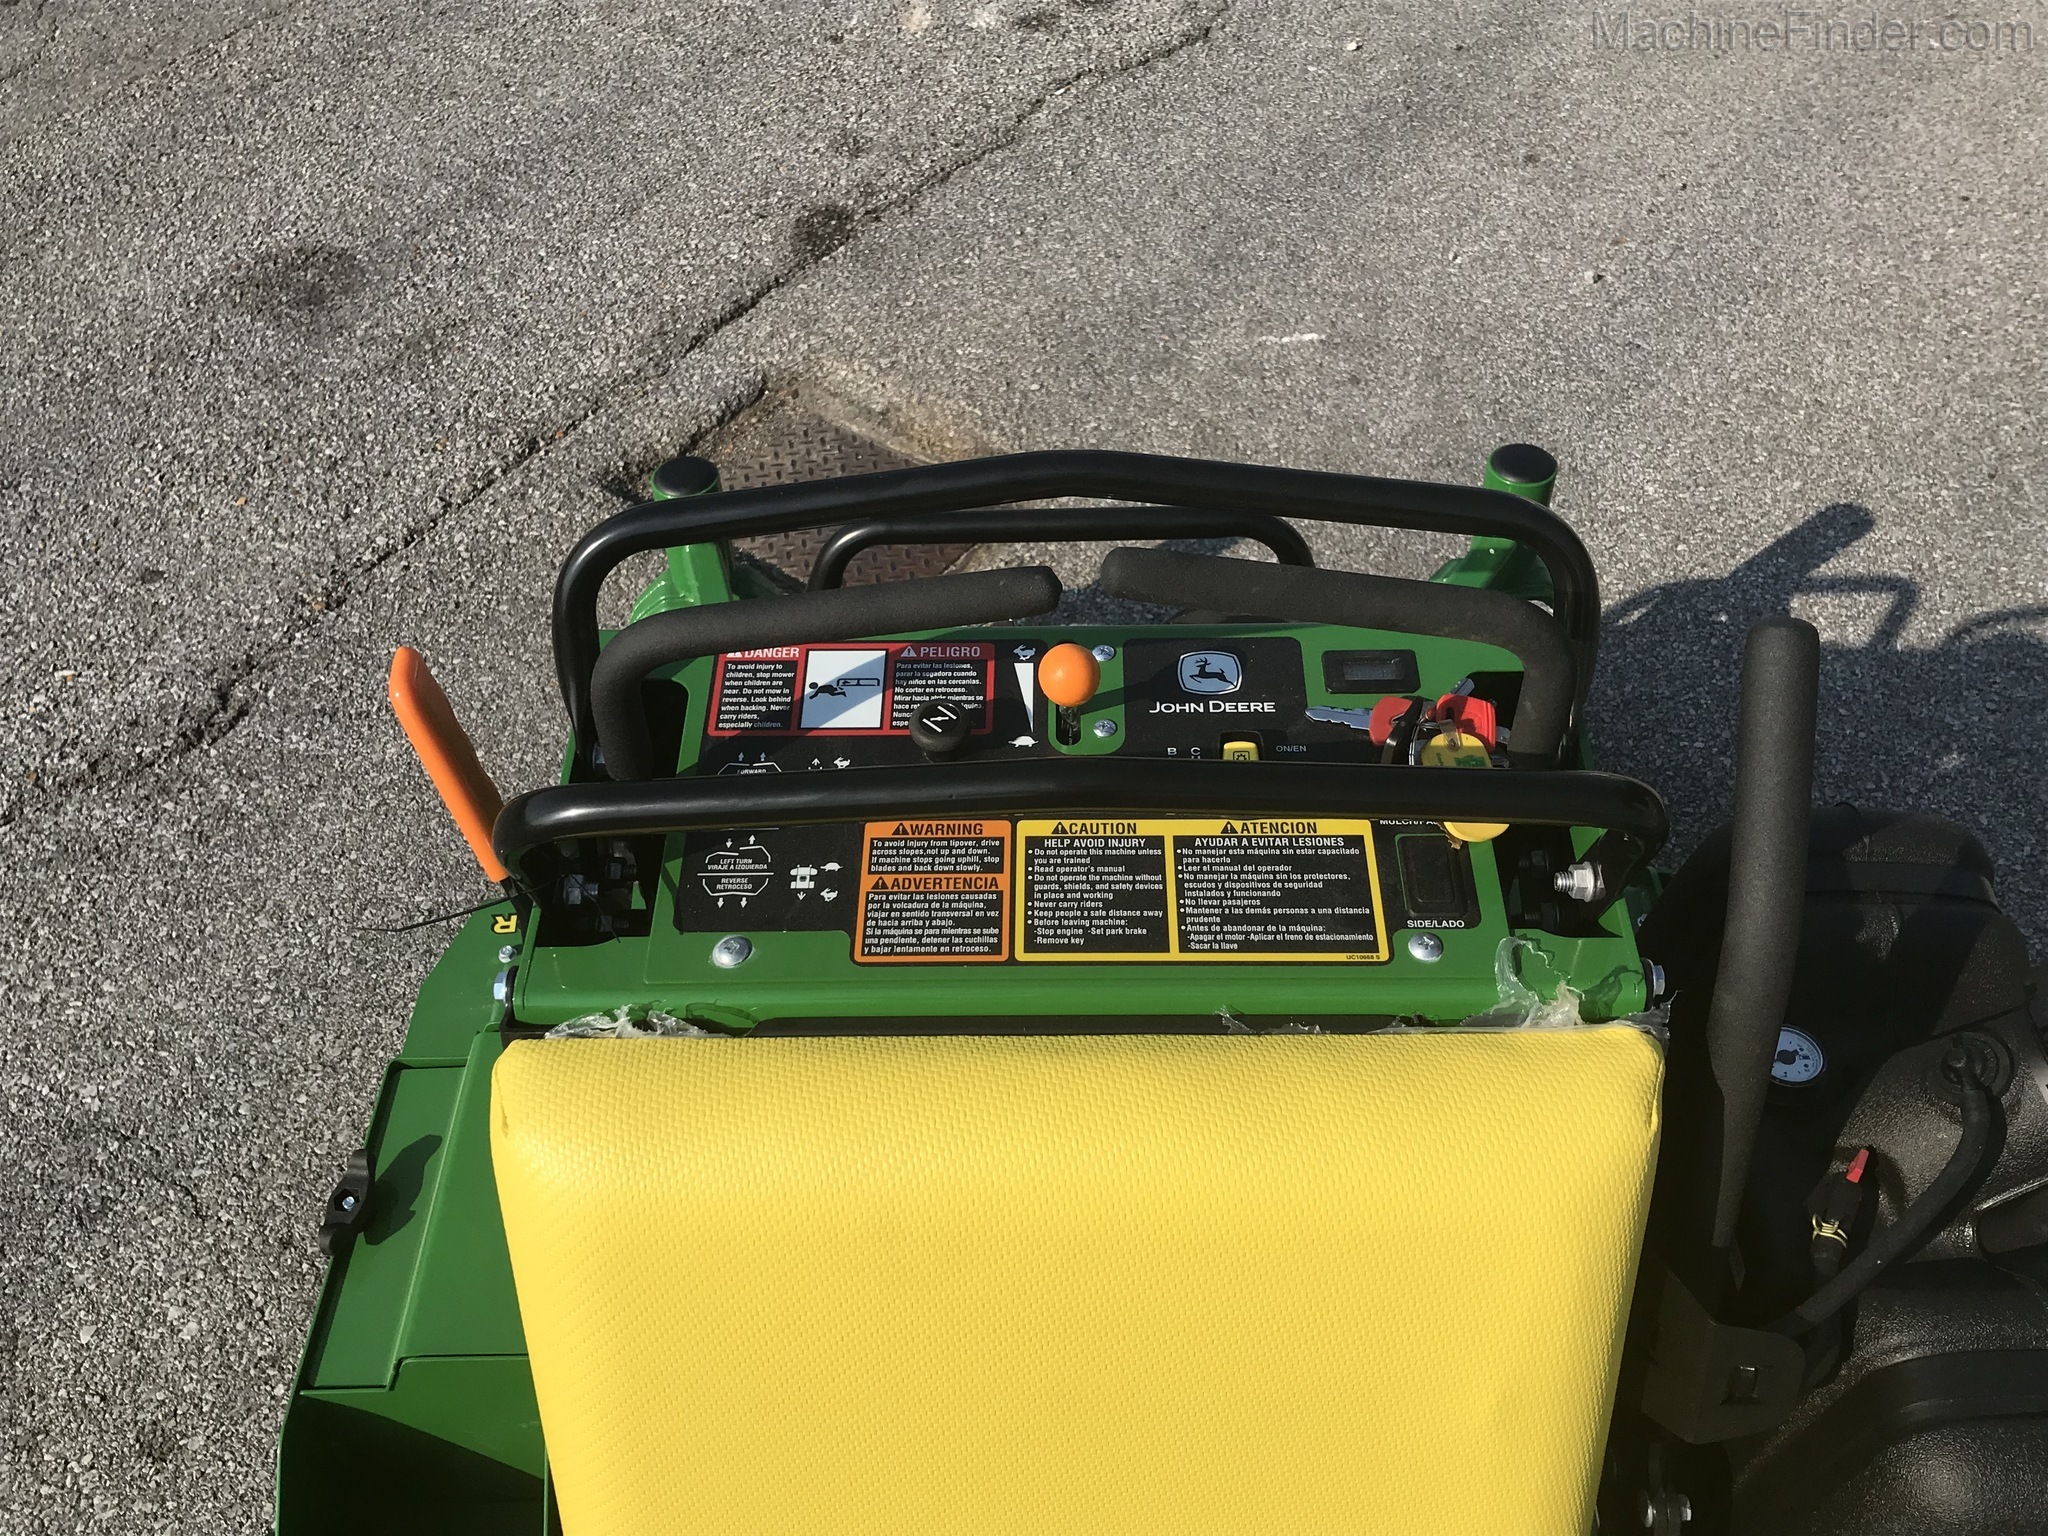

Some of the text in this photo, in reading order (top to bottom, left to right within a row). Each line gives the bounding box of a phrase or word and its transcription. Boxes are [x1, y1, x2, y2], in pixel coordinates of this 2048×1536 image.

[745, 647, 799, 658] DANGER
[920, 647, 980, 657] PELIGRO
[1149, 701, 1275, 713] JOHN DEERE
[910, 823, 983, 835] WARNING
[1069, 823, 1137, 834] CAUTION
[1241, 822, 1317, 834] ATENCION
[907, 840, 928, 848] injury
[1044, 839, 1145, 847] HELP AVOID INJURY
[1195, 838, 1344, 846] AYUDAR A EVITAR LESIONES
[913, 856, 933, 864] stops
[935, 856, 955, 864] going
[958, 856, 982, 864] uphill,
[956, 864, 983, 872] slowly.
[1257, 864, 1292, 872] operador
[891, 877, 999, 889] ADVERTENCIA
[1044, 892, 1064, 900] place
[1083, 892, 1113, 900] working
[952, 902, 986, 910] máquina,
[1058, 901, 1078, 909] carry
[1198, 898, 1220, 906] llevar
[1223, 898, 1260, 906] pasajeros
[1056, 909, 1081, 917] people
[932, 919, 955, 927] abajo.
[1106, 927, 1123, 935] park
[1213, 941, 1219, 949] la
[1221, 941, 1238, 949] llave
[871, 945, 891, 954] bajar
[893, 945, 937, 953] lentamente
[952, 945, 991, 953] retroceso.
